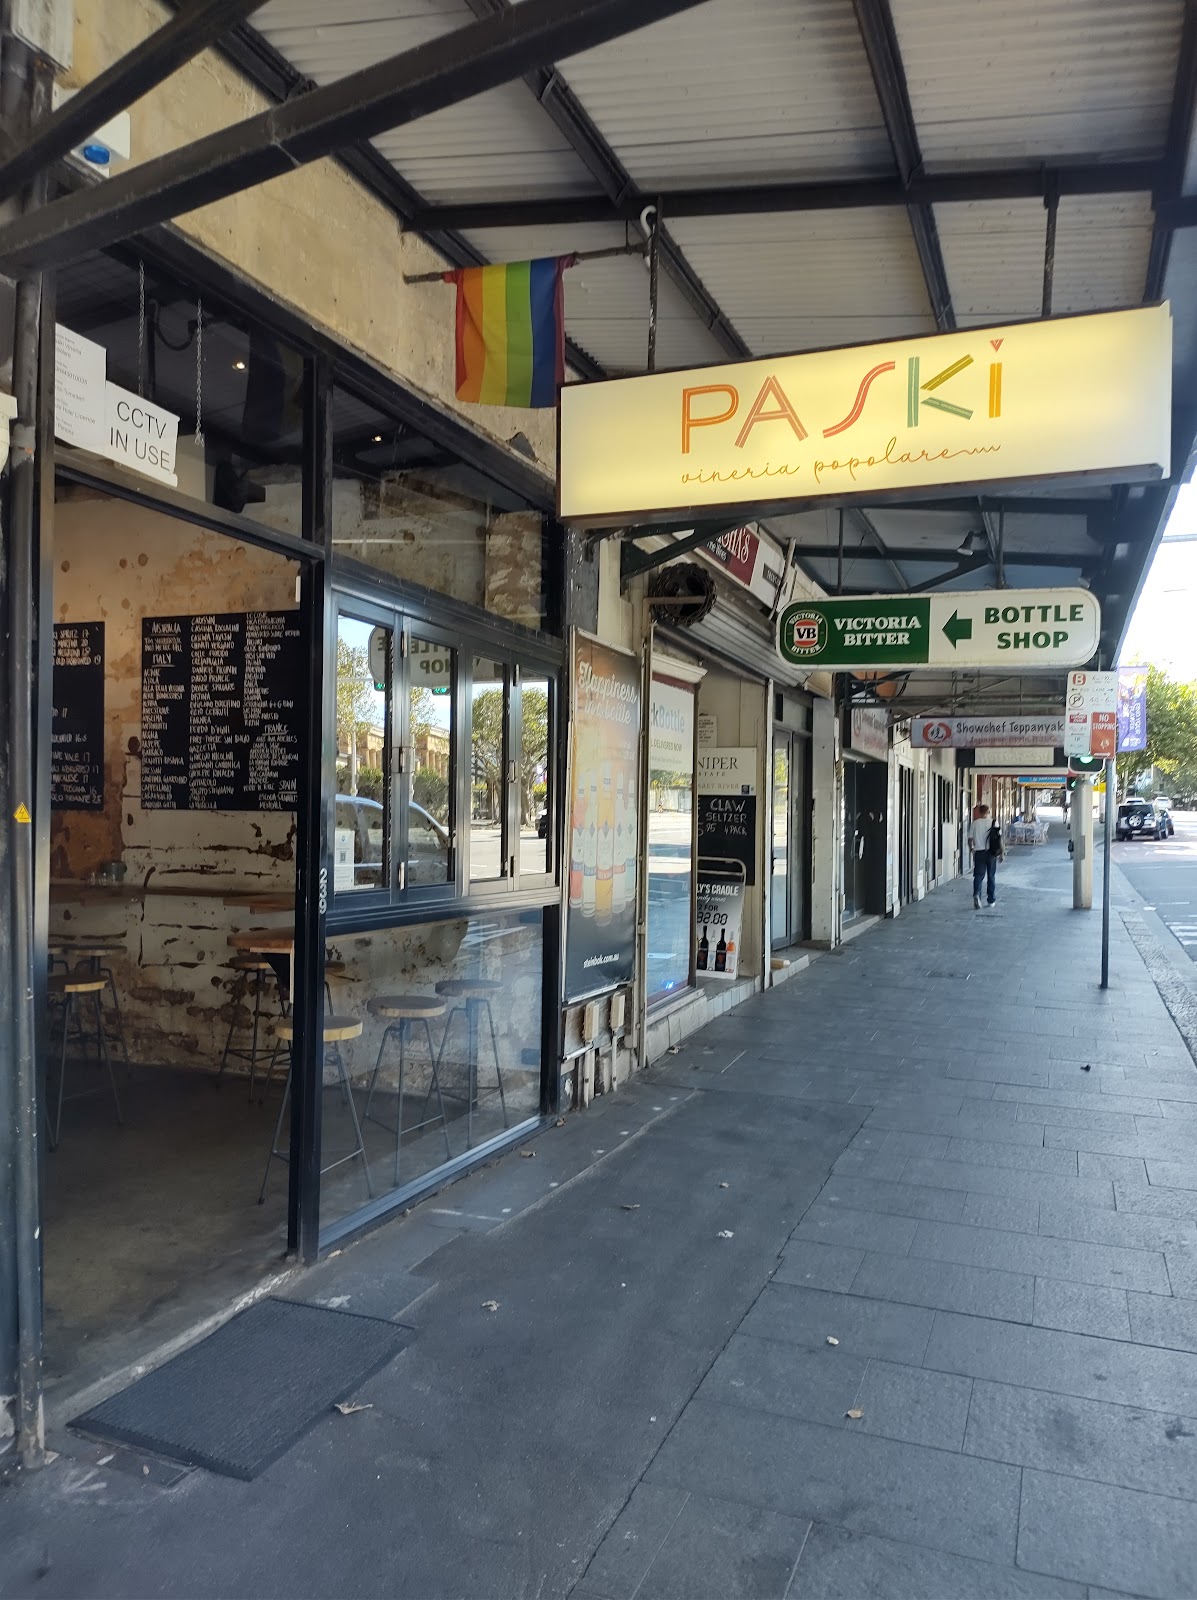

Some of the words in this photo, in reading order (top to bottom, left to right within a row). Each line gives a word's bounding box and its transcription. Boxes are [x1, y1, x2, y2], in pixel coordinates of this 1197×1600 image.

[117, 401, 167, 439] CCTV
[110, 427, 128, 453] IN
[135, 438, 171, 472] USE
[681, 462, 801, 484] vineria
[814, 437, 1001, 484] popolare
[789, 612, 823, 625] VICTORIA
[984, 604, 1084, 624] BOTTLE
[833, 616, 922, 631] VICTORIA
[796, 627, 816, 639] VB
[844, 632, 910, 647] BITTER
[997, 631, 1070, 650] SHOP
[791, 644, 821, 655] BITTER
[152, 653, 172, 665] ITALY
[579, 661, 637, 704] Happiness
[1099, 714, 1110, 722] NO
[956, 721, 1007, 734] Showchef
[1009, 721, 1065, 736] Teppanyak
[1092, 723, 1117, 731] STOPPING
[698, 757, 739, 770] NIPER
[709, 798, 746, 813] CLAW
[705, 812, 748, 824] SELTZER
[730, 825, 747, 836] PACK
[711, 884, 740, 896] CRADLE
[703, 904, 719, 912] FOR
